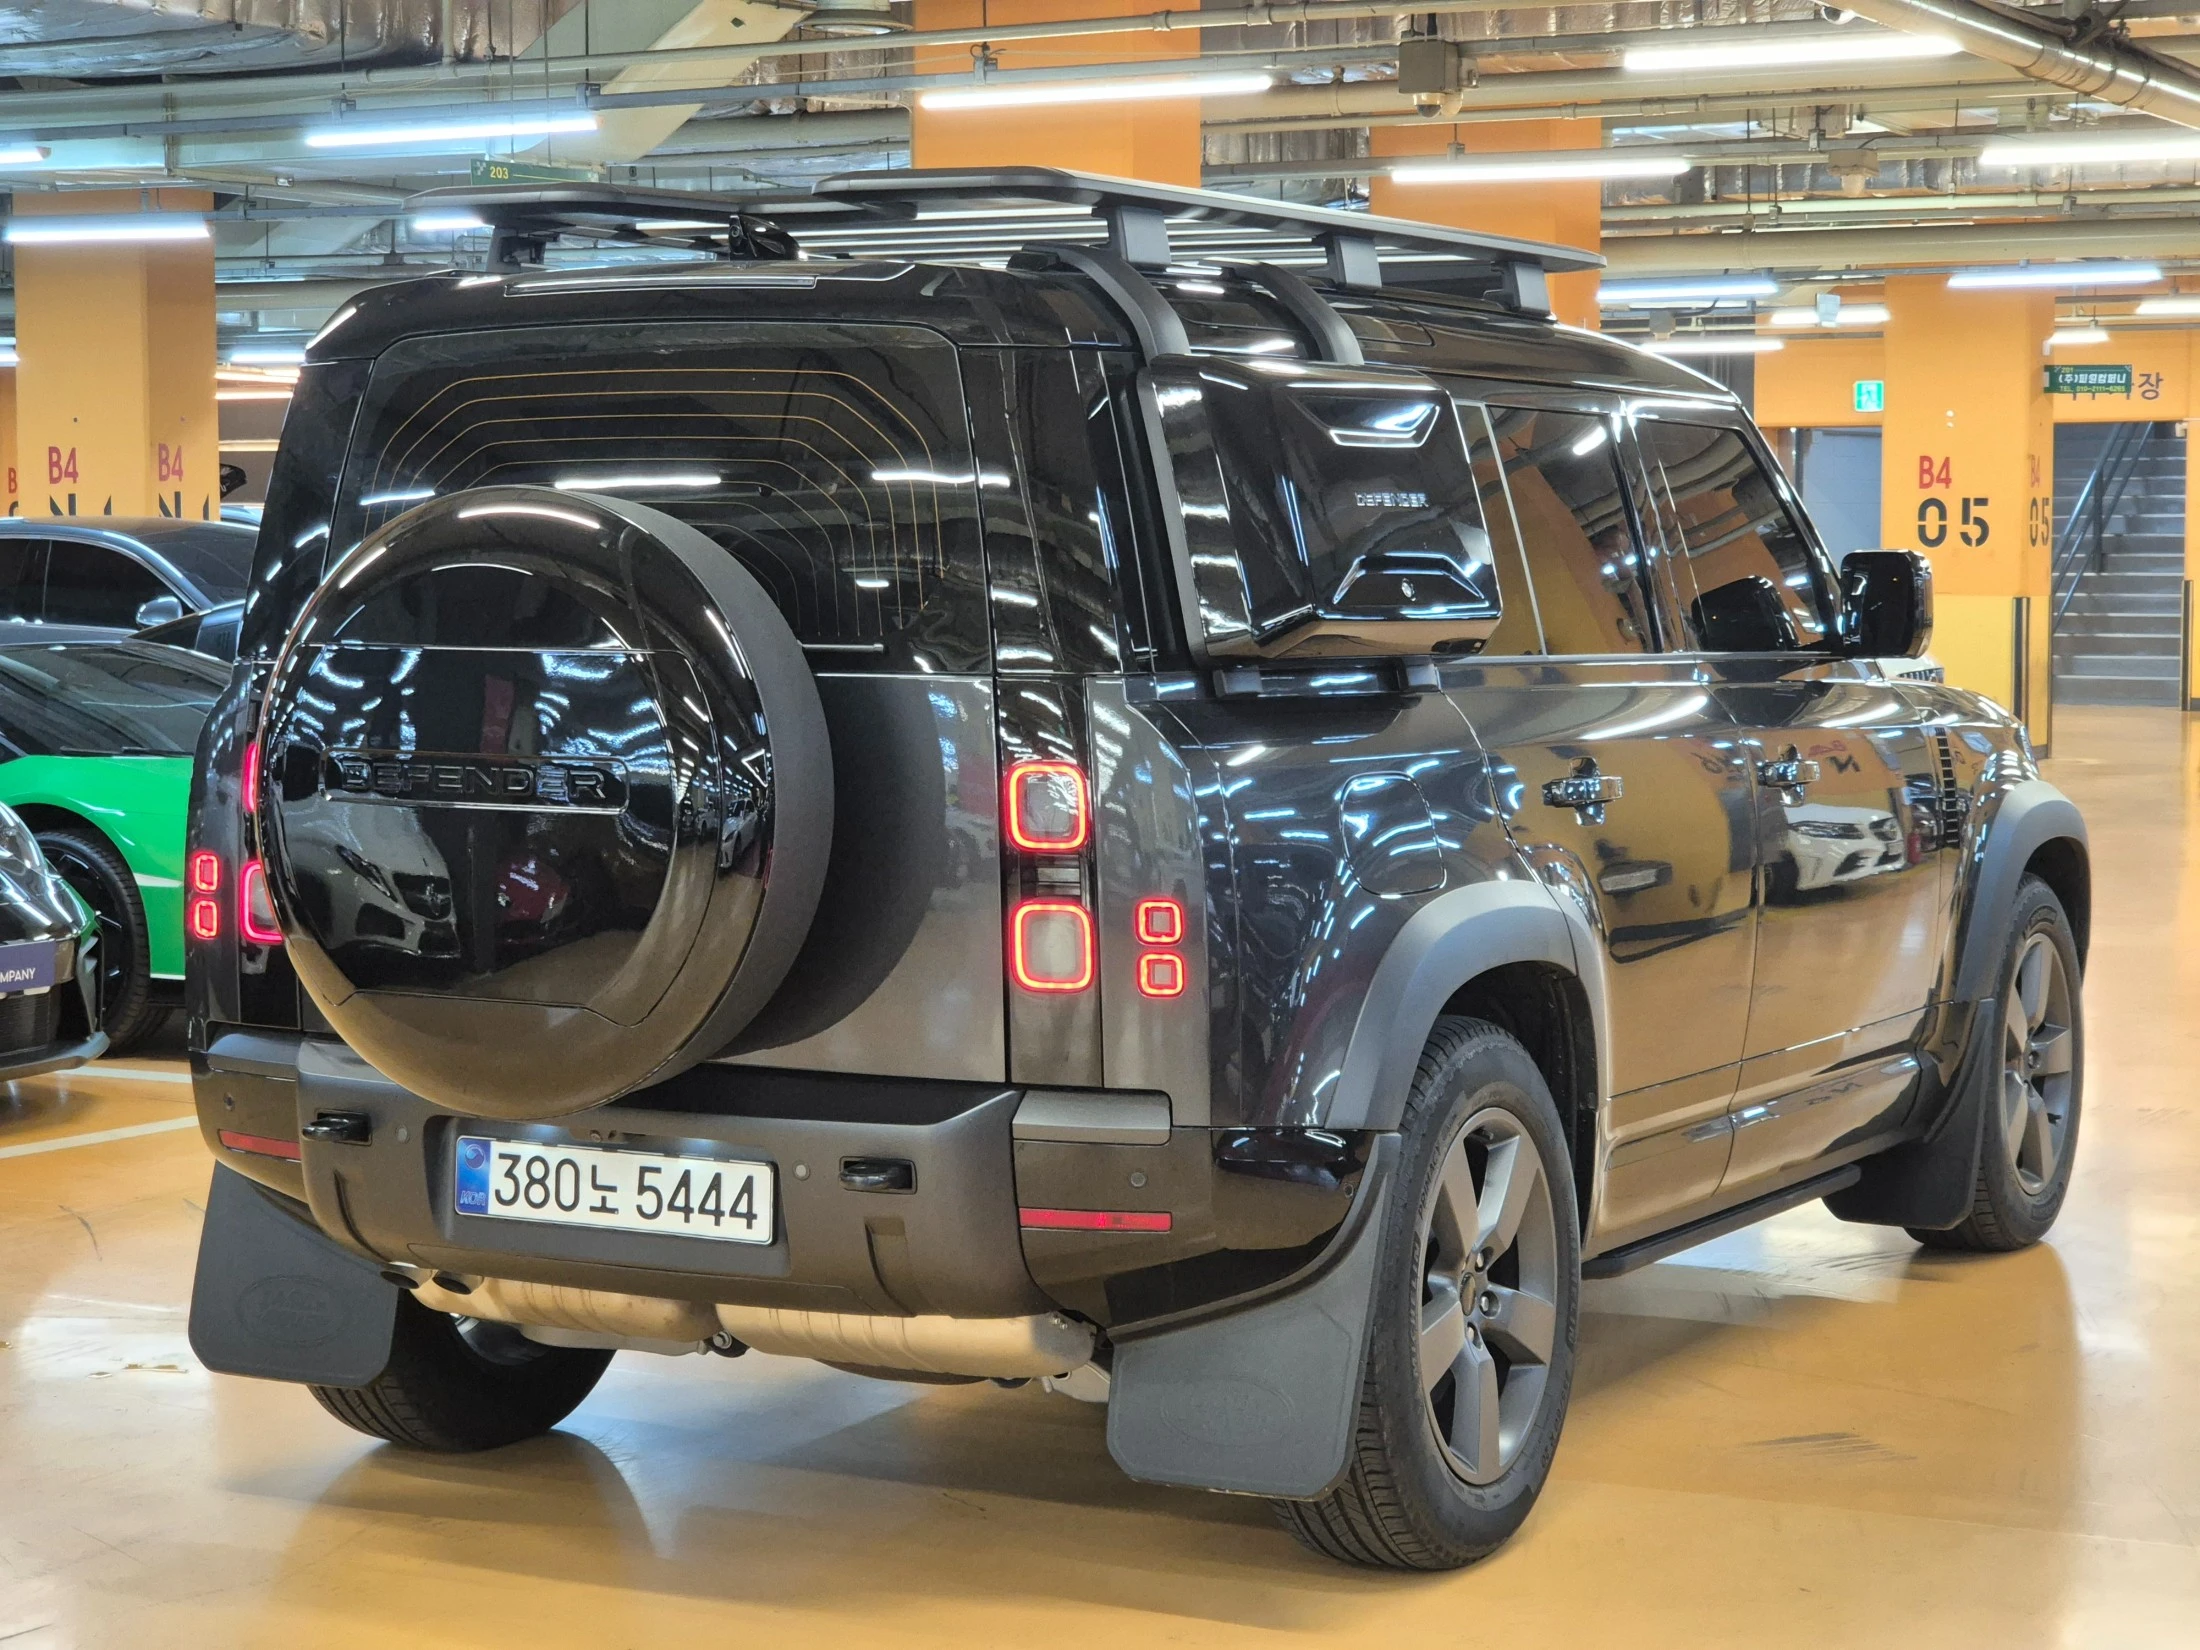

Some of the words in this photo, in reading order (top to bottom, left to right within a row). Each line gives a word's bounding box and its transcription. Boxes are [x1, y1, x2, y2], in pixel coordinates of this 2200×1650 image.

[489, 166, 509, 179] 203
[8, 467, 18, 494] B
[48, 446, 79, 484] B4
[158, 443, 184, 482] B4
[1919, 455, 1952, 489] B4
[1355, 492, 1429, 507] DEFENDER
[1917, 497, 1990, 547] 05
[2029, 497, 2050, 547] 05
[341, 759, 607, 799] DEFENDER
[460, 1190, 487, 1206] KOR
